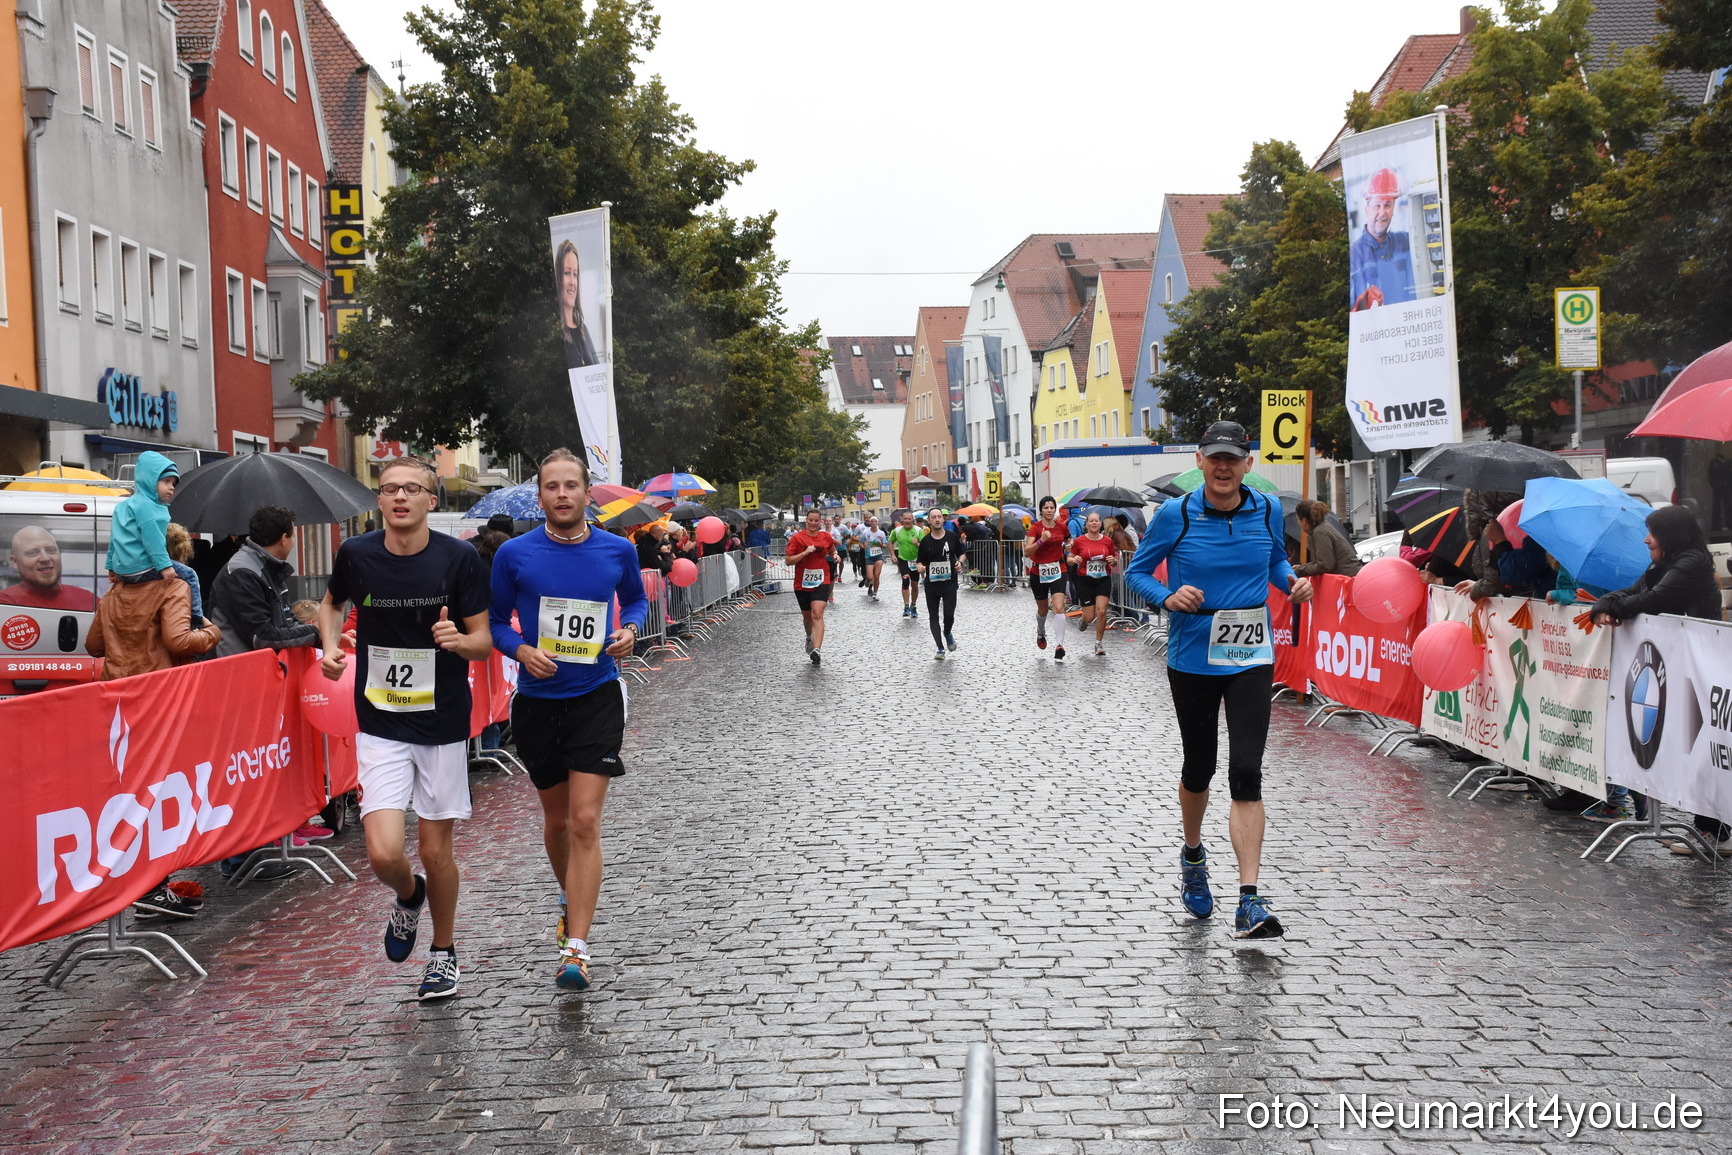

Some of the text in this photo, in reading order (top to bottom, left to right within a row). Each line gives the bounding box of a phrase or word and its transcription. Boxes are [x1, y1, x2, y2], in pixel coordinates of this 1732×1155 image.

[106, 368, 165, 430] Eilles
[1267, 393, 1306, 407] Block
[1273, 412, 1298, 449] C
[950, 466, 964, 479] KL
[989, 480, 998, 494] D
[744, 490, 754, 503] D
[805, 573, 822, 581] 2754
[931, 567, 949, 575] 2601
[372, 595, 449, 608] GOSSEN METRAWATT
[554, 613, 595, 640] 196
[1217, 622, 1264, 645] 2729
[555, 643, 588, 655] Bastian
[19, 662, 83, 671] 09181 48 48-0
[1631, 644, 1666, 688] BMW
[386, 664, 413, 688] 42
[386, 693, 411, 703] Oliver
